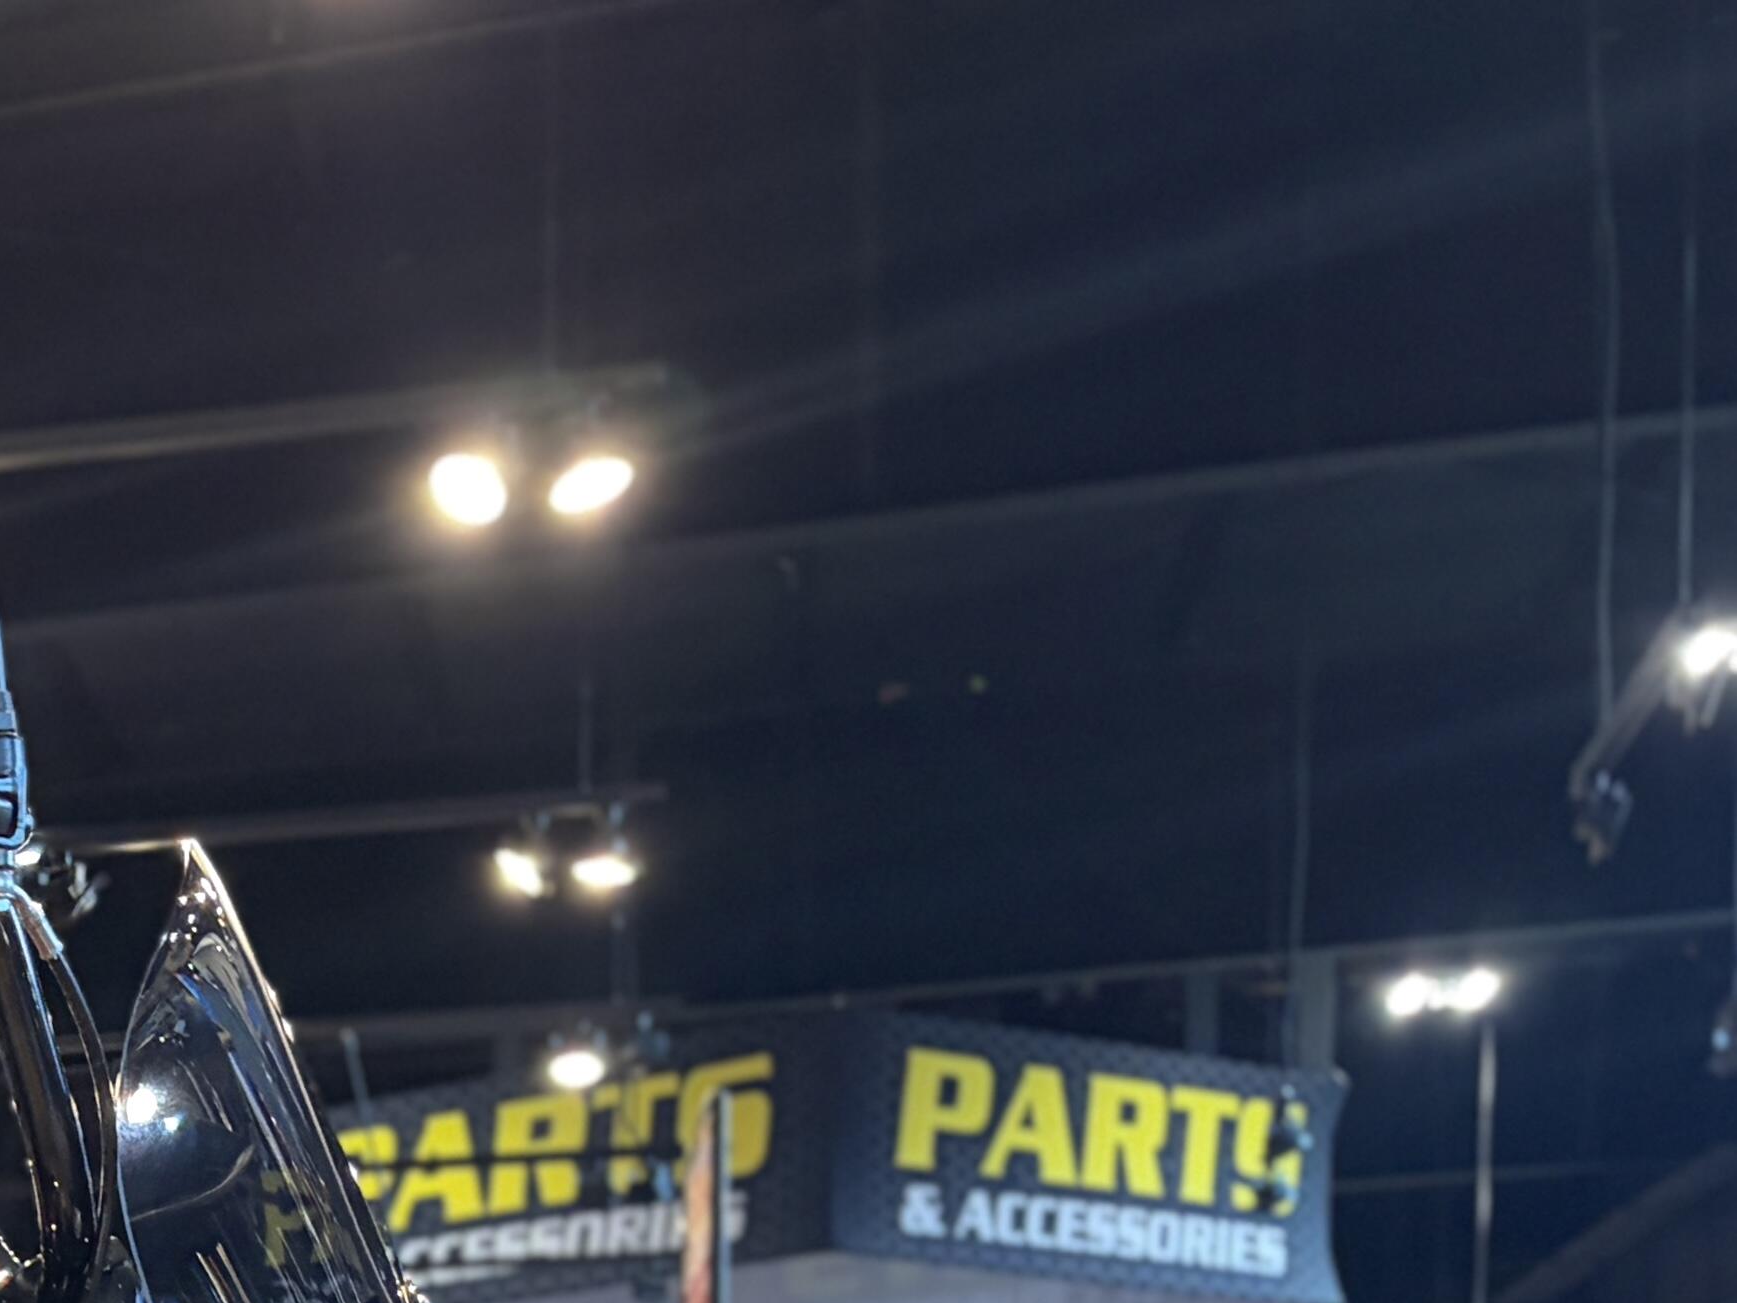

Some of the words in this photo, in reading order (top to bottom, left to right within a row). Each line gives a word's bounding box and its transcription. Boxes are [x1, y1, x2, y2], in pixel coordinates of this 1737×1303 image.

[893, 1047, 1309, 1218] PARTS
[898, 1182, 945, 1238] &
[953, 1187, 1288, 1278] ACCESSORIES
